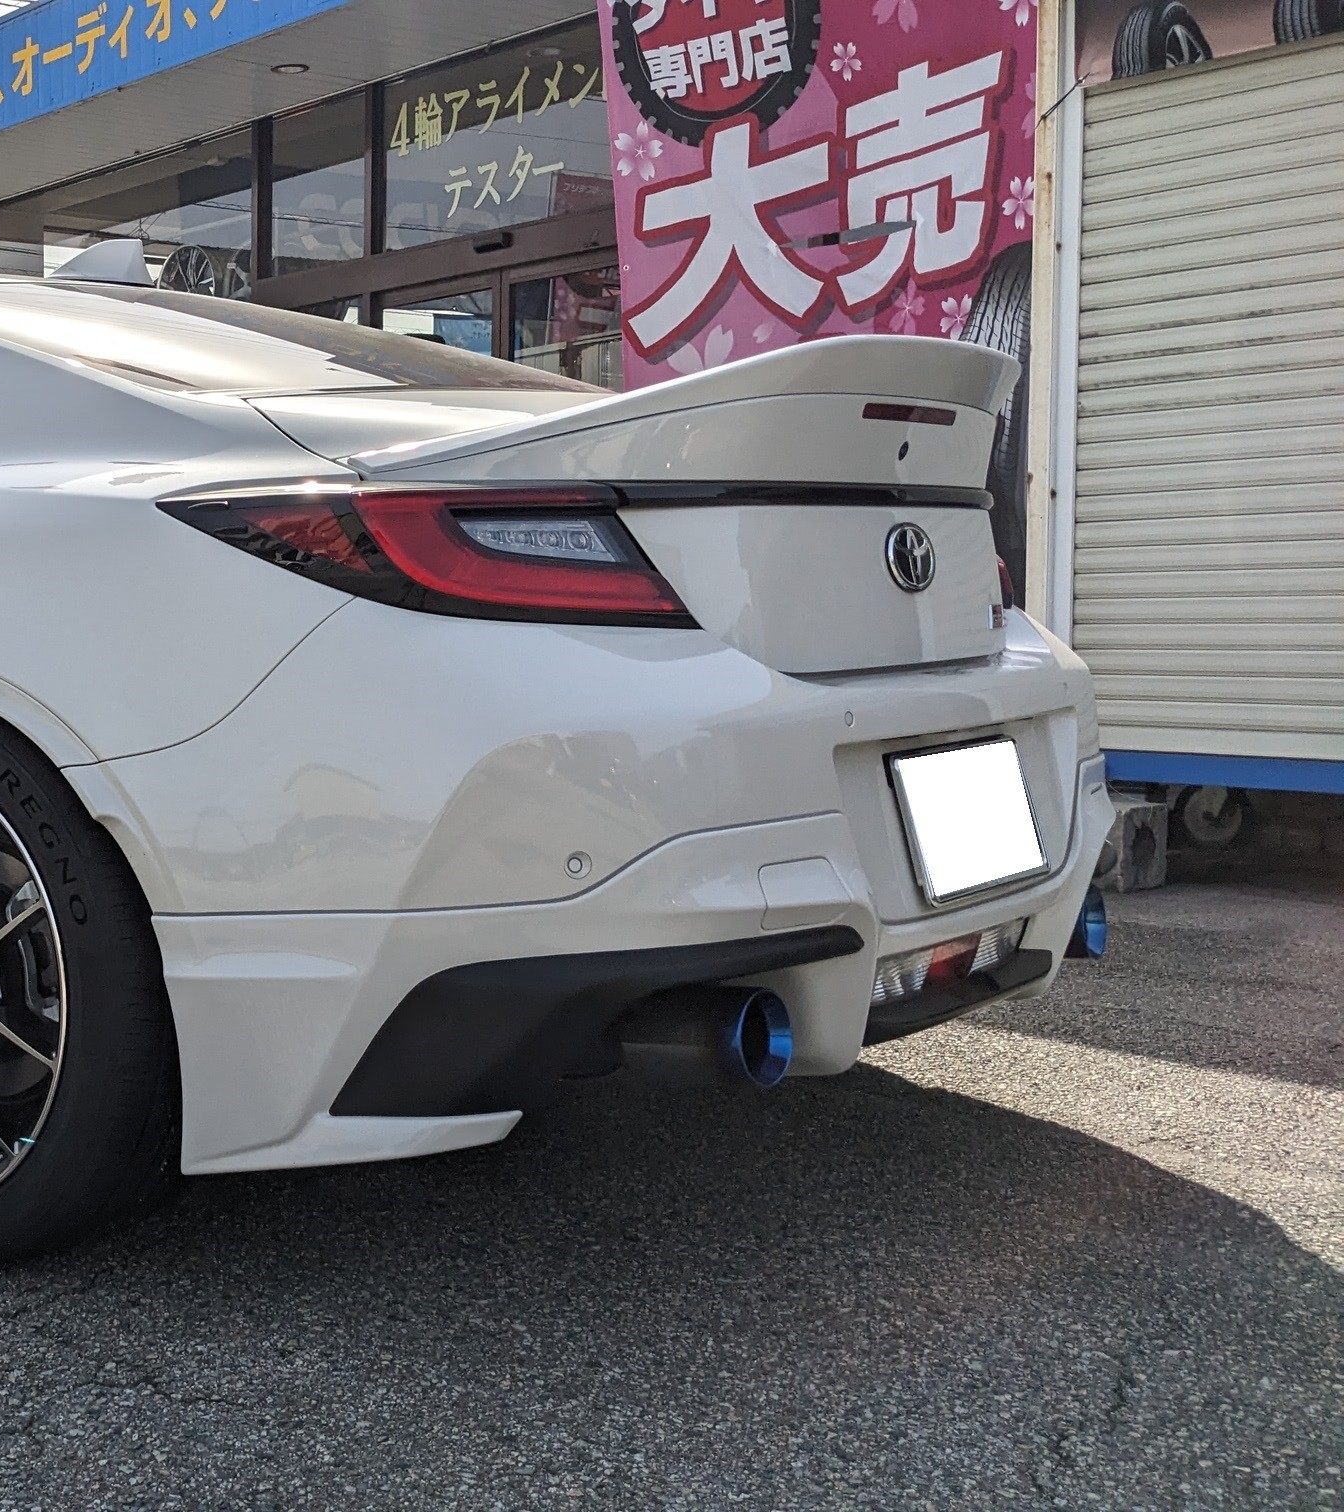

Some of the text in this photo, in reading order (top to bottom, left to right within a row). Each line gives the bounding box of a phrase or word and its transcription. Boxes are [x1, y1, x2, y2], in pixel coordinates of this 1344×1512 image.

[643, 17, 792, 98] 専門店
[445, 145, 564, 219] テスター
